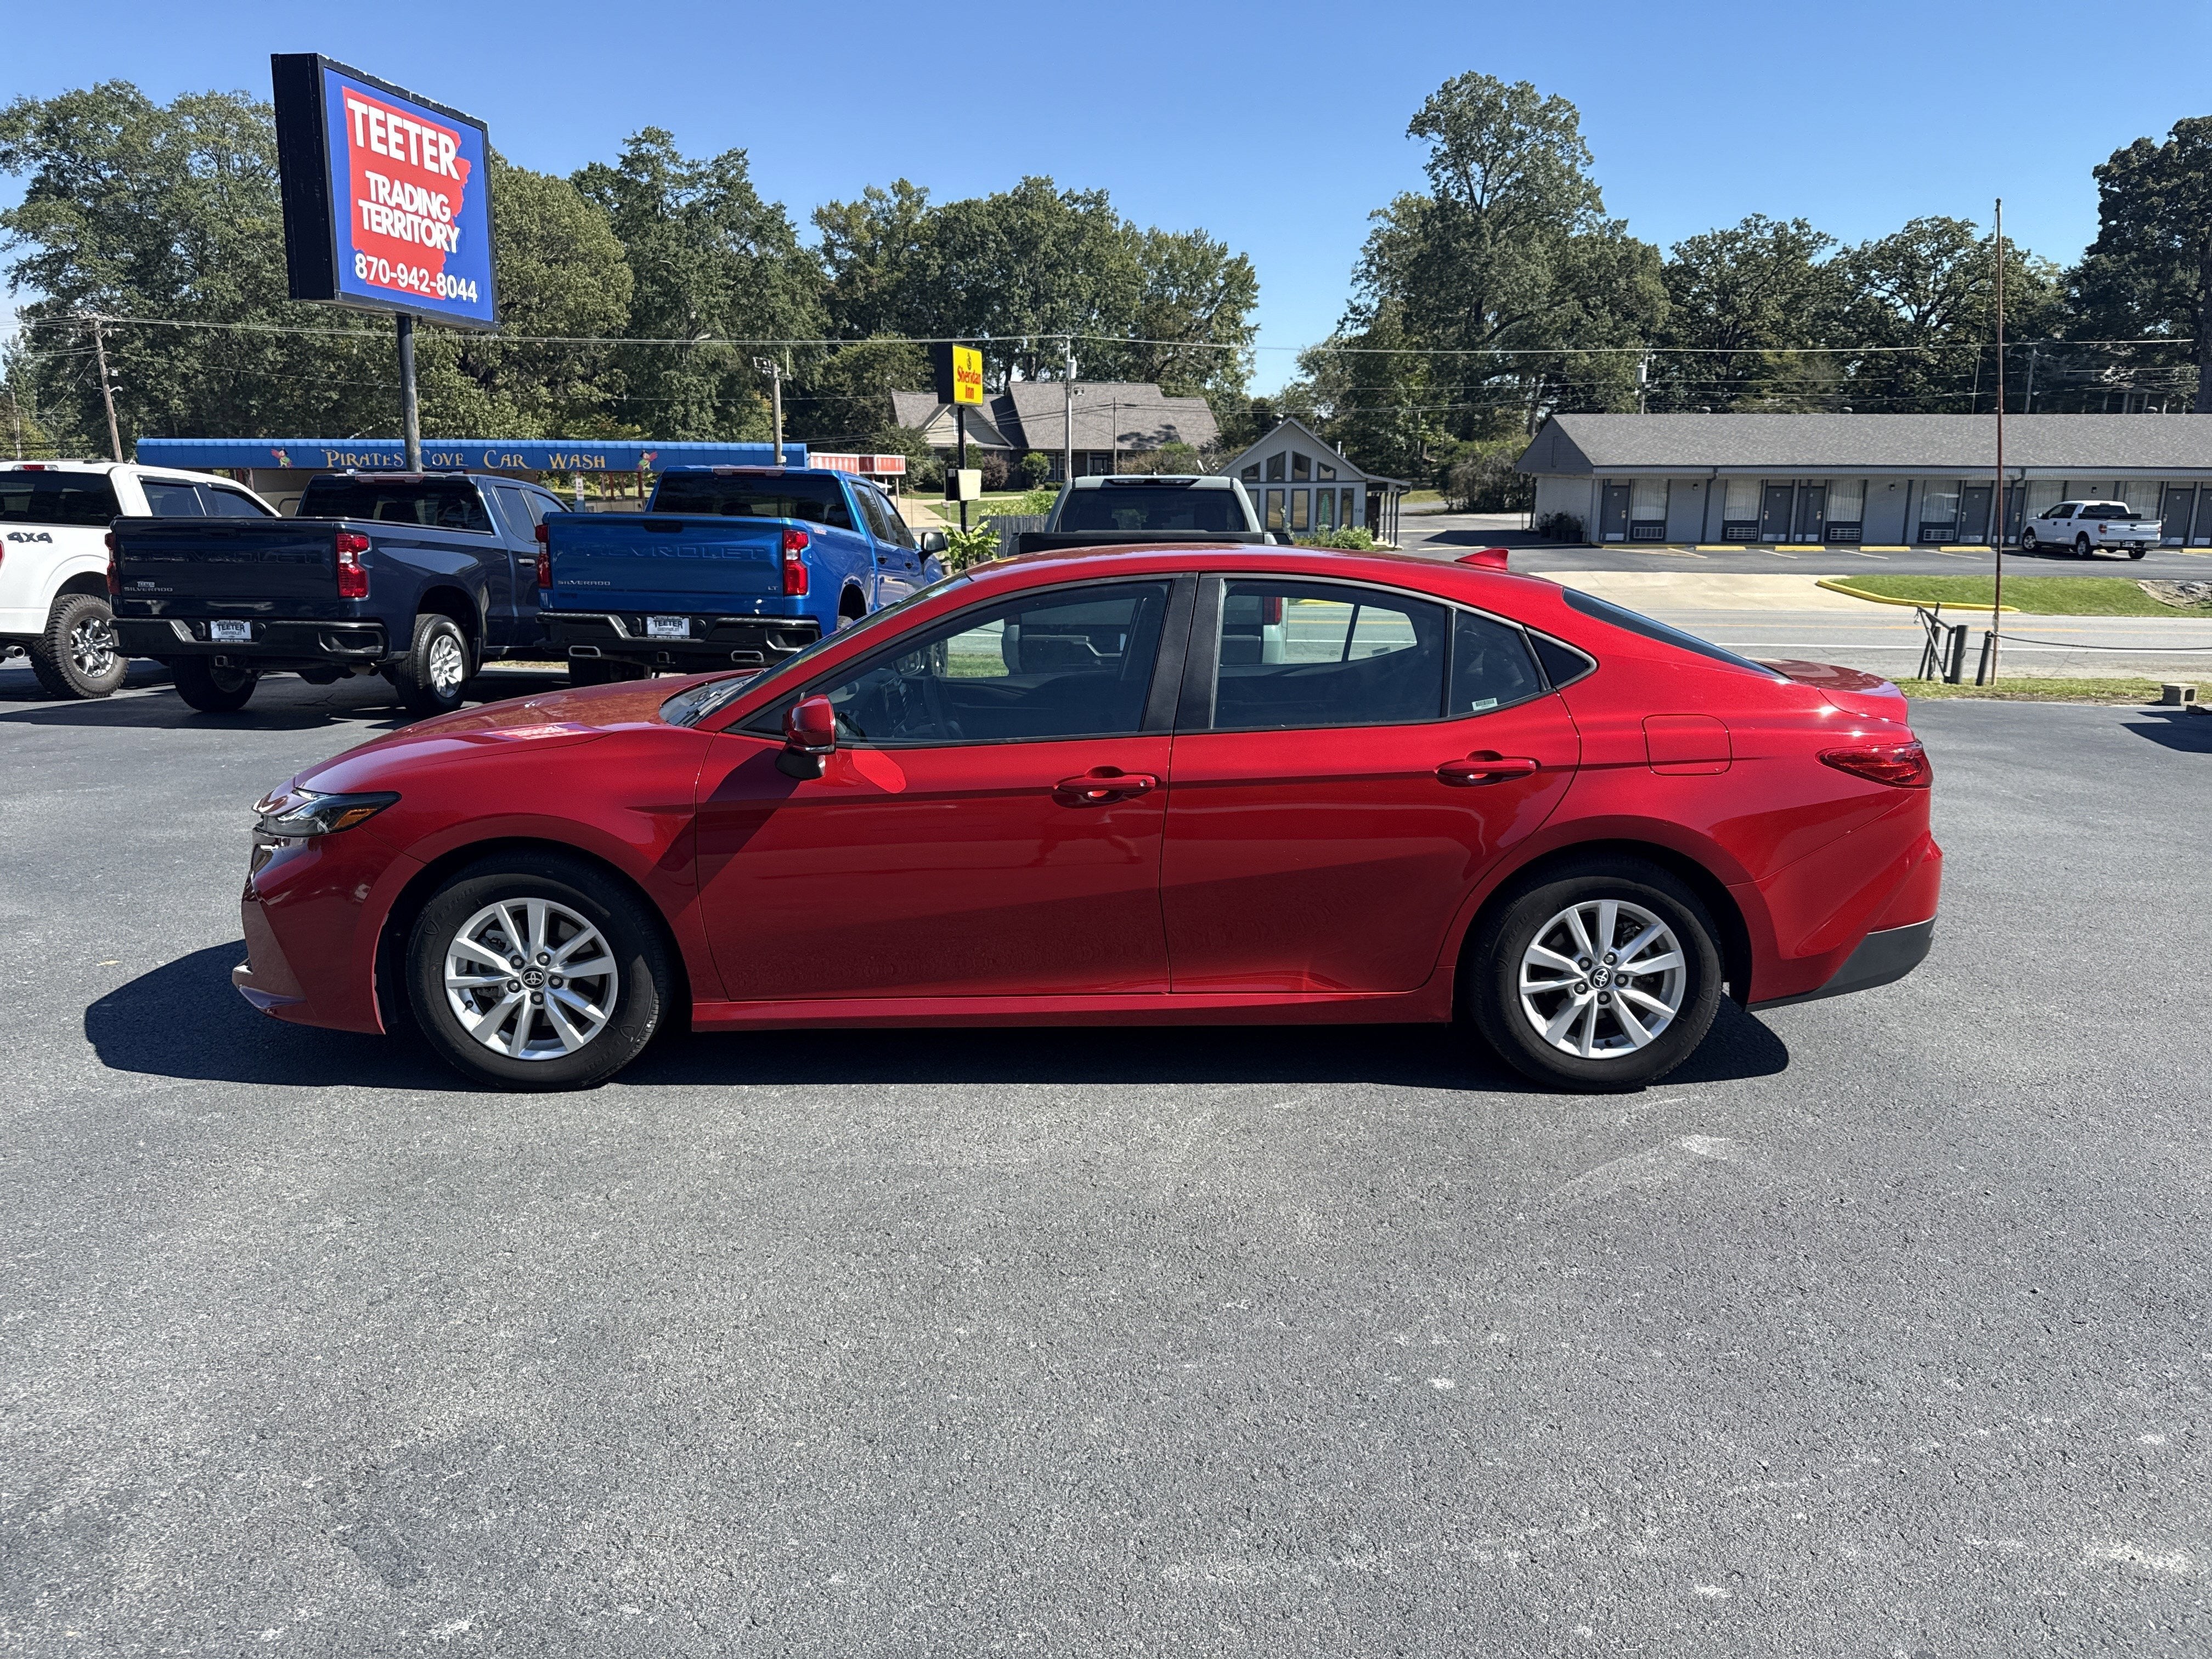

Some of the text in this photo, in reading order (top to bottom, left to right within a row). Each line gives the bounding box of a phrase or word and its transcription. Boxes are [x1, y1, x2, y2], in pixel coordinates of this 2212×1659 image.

[347, 98, 460, 180] TEETER
[365, 171, 451, 223] TRADING
[358, 199, 460, 253] TERRITORY
[355, 253, 478, 303] 870-942-8044
[321, 448, 404, 467] PIRATES
[483, 450, 532, 469] CAR
[549, 453, 606, 470] WASH
[217, 624, 245, 633] TEETER
[653, 619, 683, 629] TEETER
